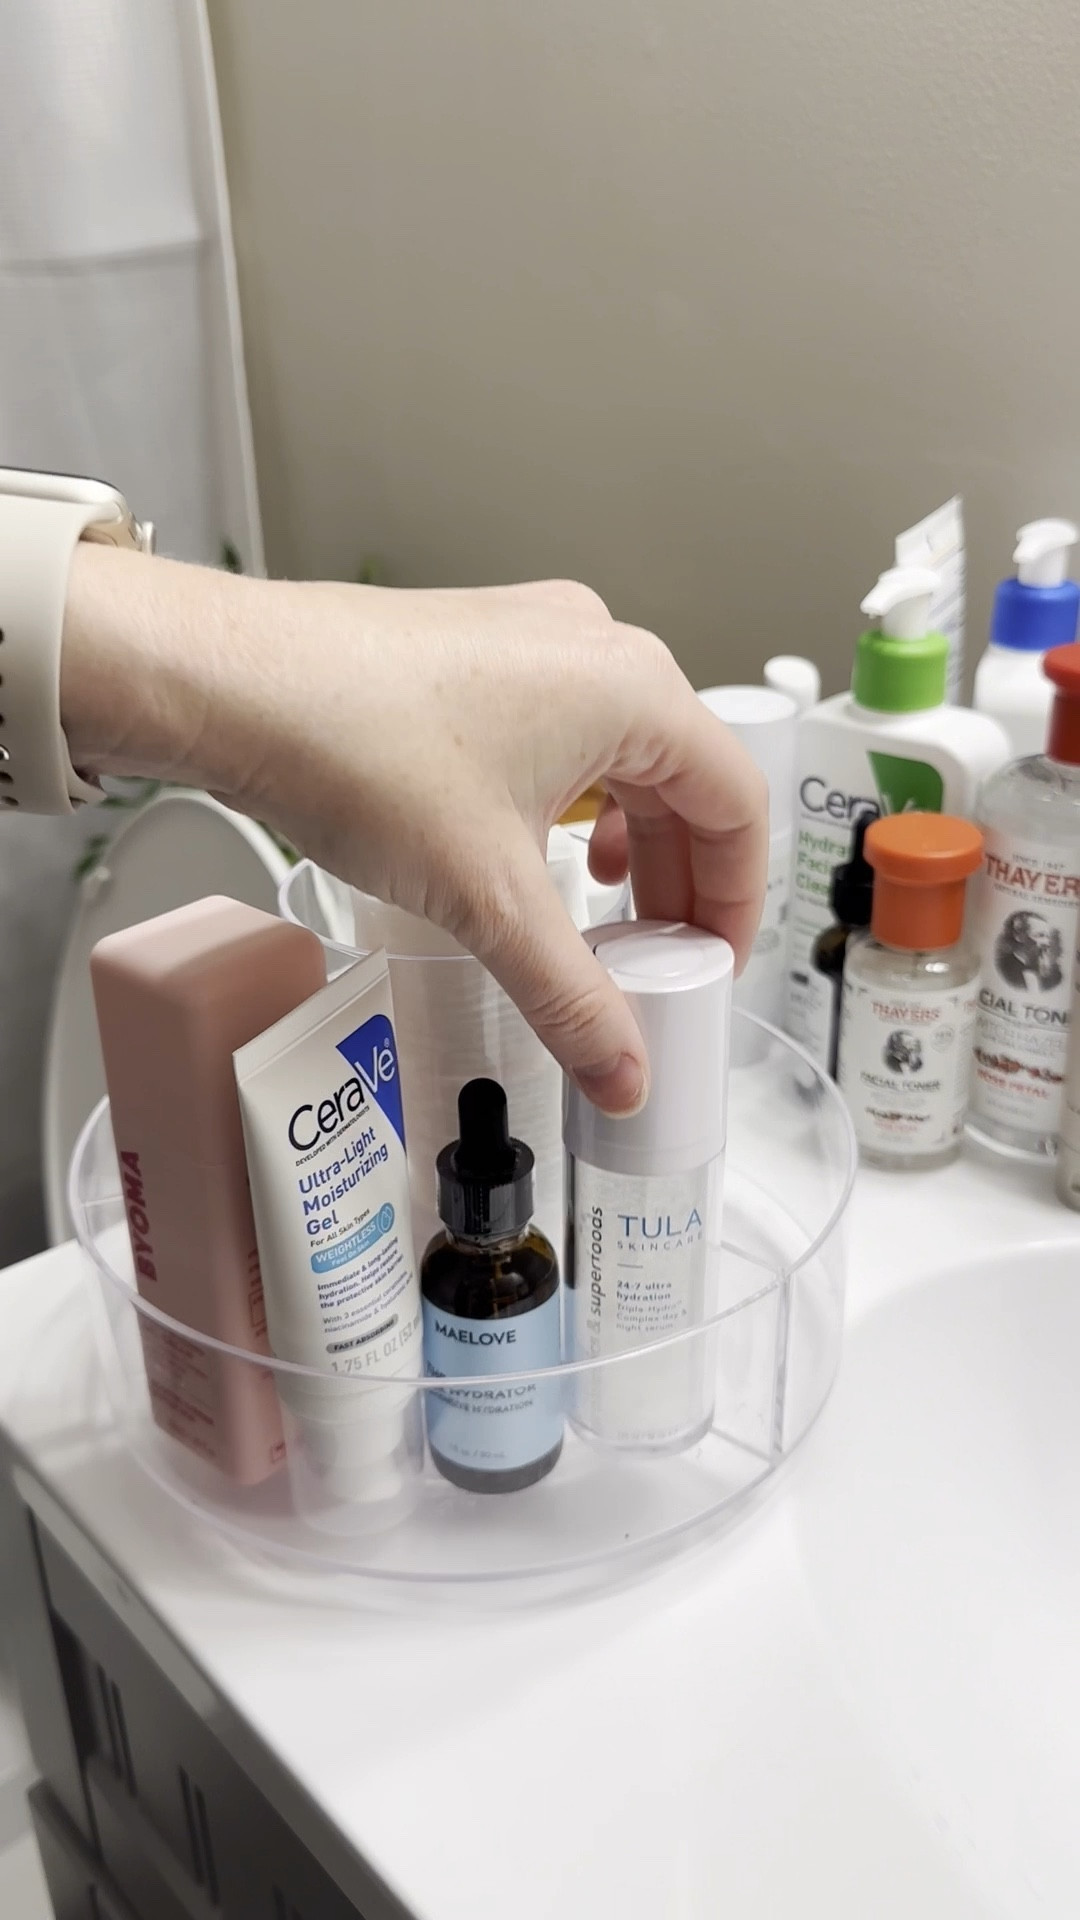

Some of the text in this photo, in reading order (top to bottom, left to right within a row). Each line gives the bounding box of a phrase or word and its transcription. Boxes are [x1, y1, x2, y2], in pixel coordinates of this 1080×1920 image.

[984, 852, 1080, 899] THAYER
[872, 1001, 942, 1021] THAYERS
[295, 1105, 370, 1167] DEVELOPED WITH DERMATOLOGISTS
[298, 1125, 376, 1194] Ultra-Light
[303, 1143, 389, 1216] Moisturizing
[121, 1151, 158, 1282] BYOMA
[306, 1210, 340, 1236] Gel
[310, 1208, 370, 1248] For All Skin Types
[617, 1208, 702, 1239] TULA
[315, 1221, 376, 1264] WEIGHTLESS
[617, 1231, 703, 1251] SKINCARE
[317, 1270, 360, 1291] Immediate
[320, 1299, 335, 1309] the
[336, 1283, 374, 1307] protective
[374, 1271, 388, 1285] skin
[361, 1267, 380, 1286] Helps
[617, 1280, 672, 1290] 24-7 ultra
[323, 1315, 342, 1325] With
[350, 1293, 382, 1317] essential
[616, 1290, 671, 1302] hydration
[324, 1313, 373, 1334] niacinamide
[434, 1319, 517, 1346] MAELOVE
[616, 1312, 659, 1323] Complex
[616, 1323, 641, 1332] night
[333, 1340, 354, 1352] FAST
[355, 1319, 396, 1346] ABSORBING
[331, 1356, 362, 1373] 1.75
[365, 1349, 381, 1366] FL
[383, 1336, 398, 1357] OZ
